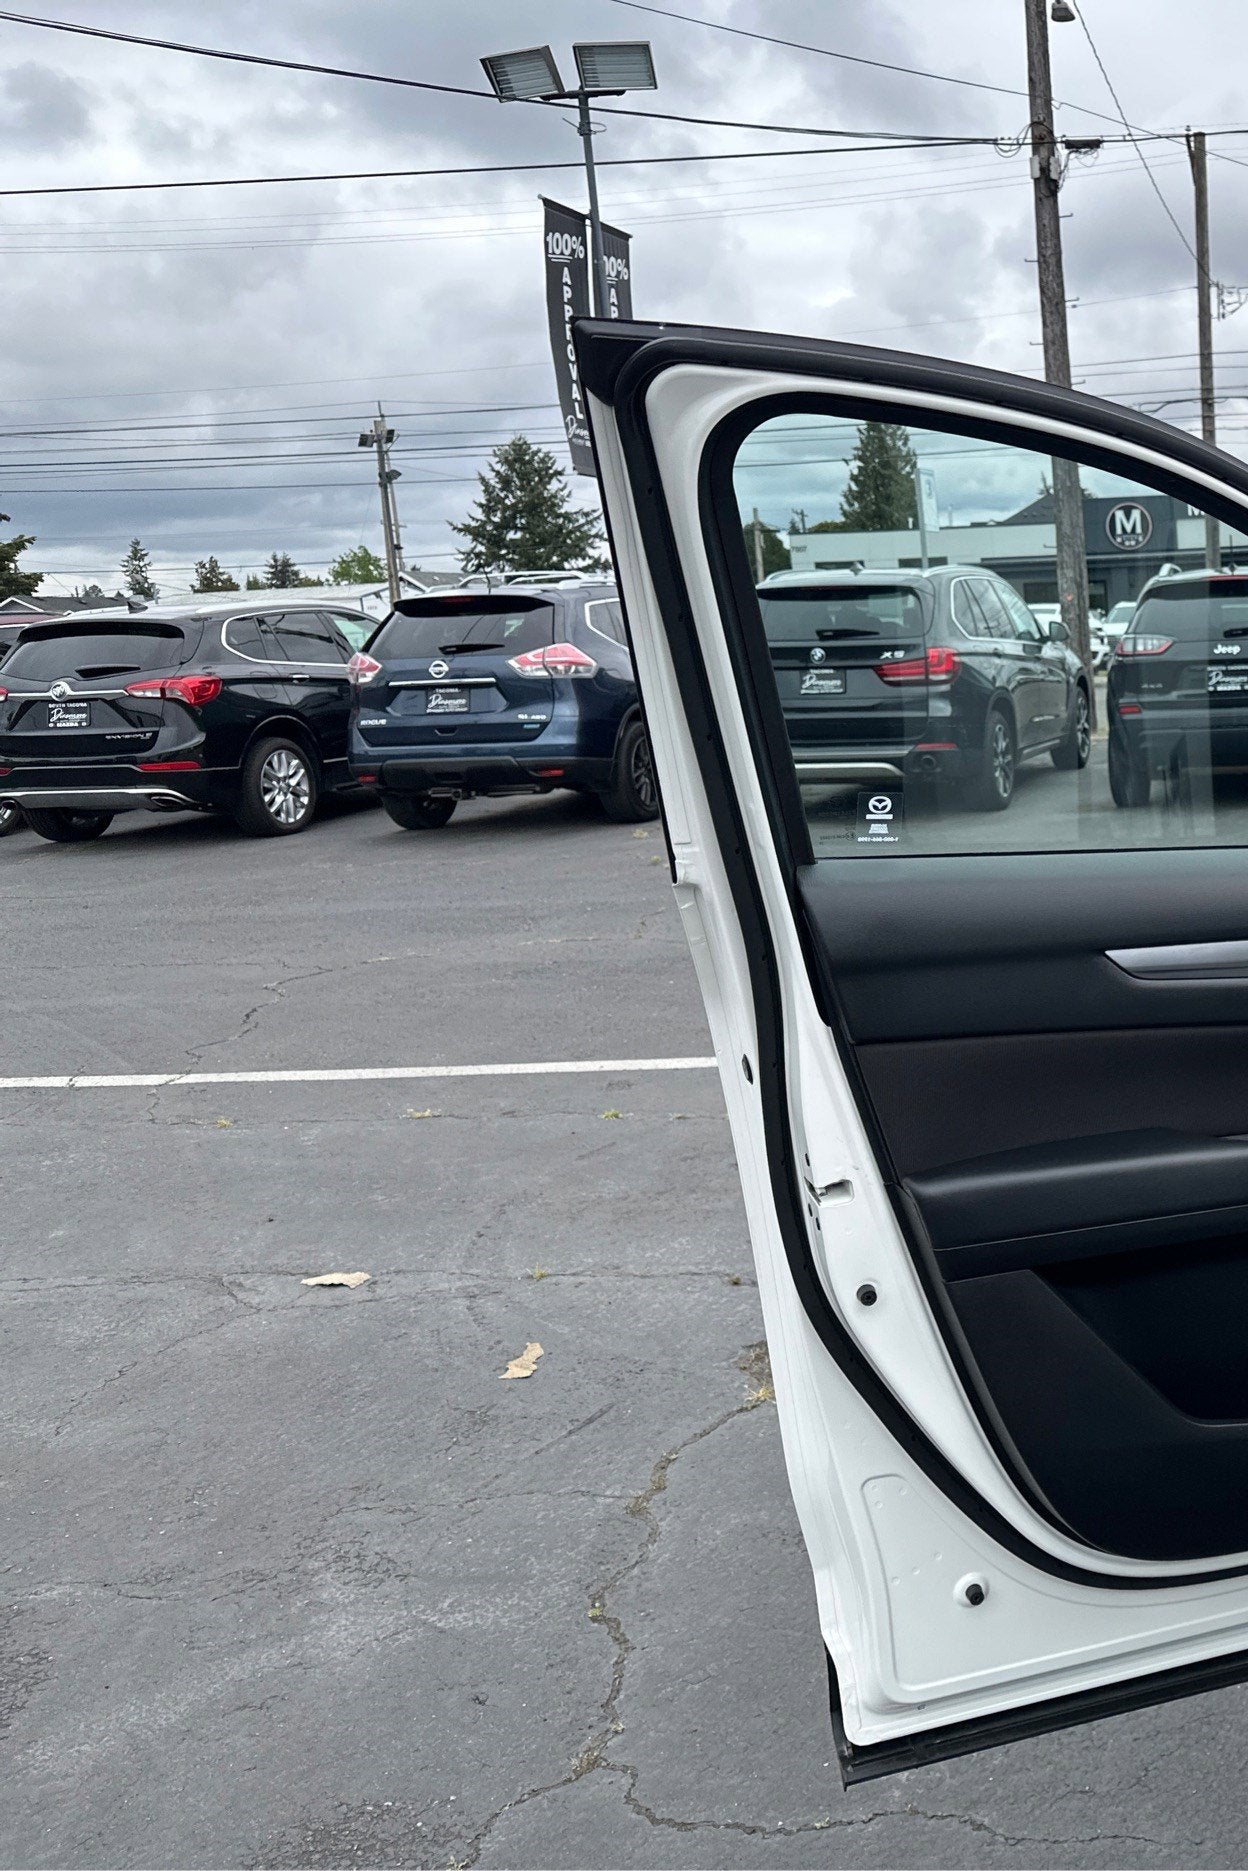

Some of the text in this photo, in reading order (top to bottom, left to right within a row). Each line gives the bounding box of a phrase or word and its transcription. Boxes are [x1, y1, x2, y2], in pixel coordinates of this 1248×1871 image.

[546, 231, 585, 259] 100%
[1213, 644, 1241, 655] Jeep
[360, 718, 387, 726] ROGUE
